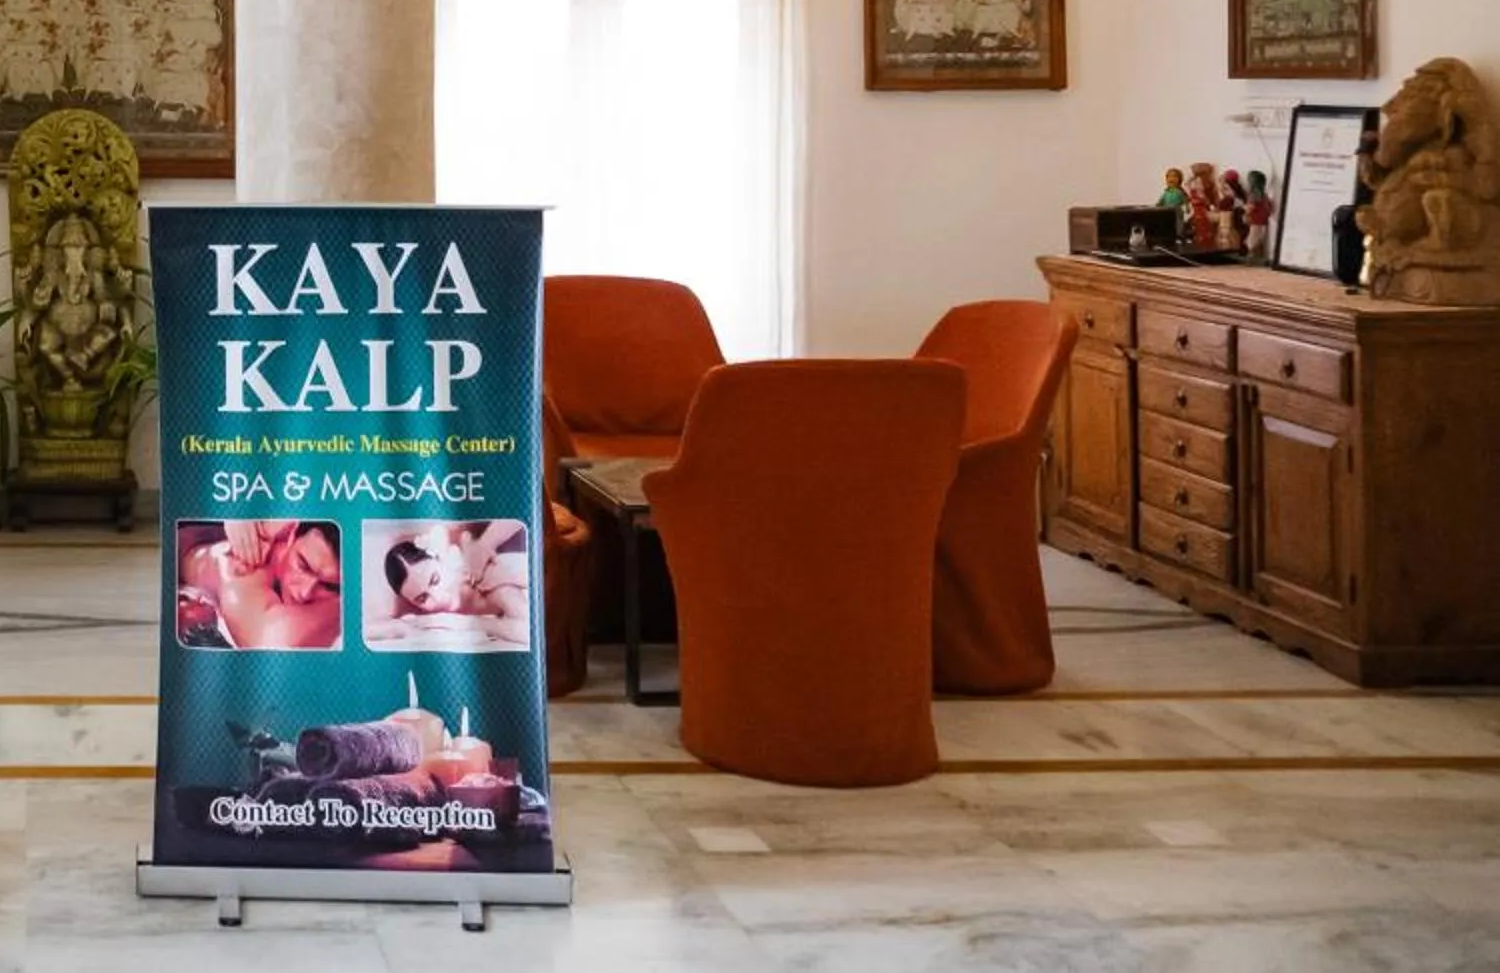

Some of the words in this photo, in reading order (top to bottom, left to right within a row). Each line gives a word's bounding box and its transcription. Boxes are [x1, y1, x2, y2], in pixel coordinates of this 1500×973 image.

[208, 241, 487, 316] KAYA
[217, 338, 483, 412] KALP
[181, 435, 252, 454] (Kerala
[258, 435, 355, 457] Ayurvedic
[360, 435, 440, 458] Massage
[445, 435, 515, 455] Center)
[212, 471, 274, 502] SPA
[283, 471, 311, 501] &
[320, 471, 485, 502] MASSAGE
[210, 796, 315, 826] Contact
[319, 798, 358, 826] To
[363, 800, 496, 834] Reception
